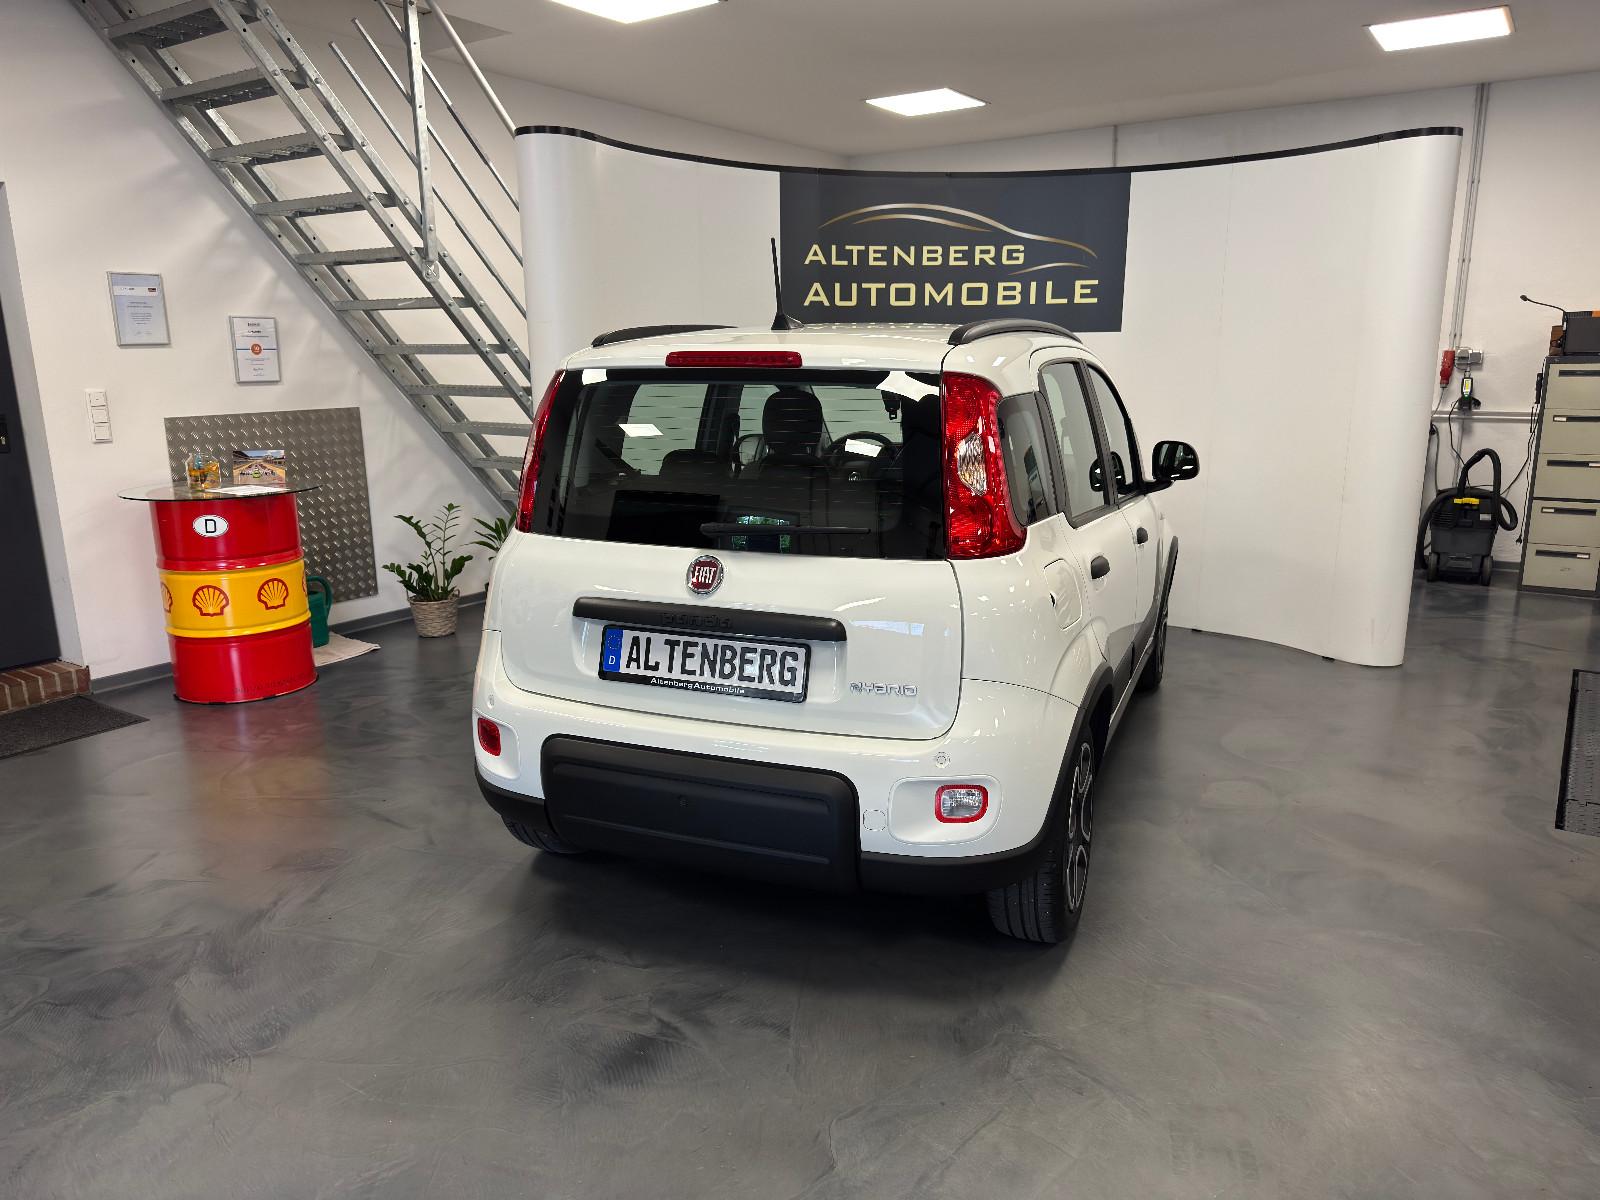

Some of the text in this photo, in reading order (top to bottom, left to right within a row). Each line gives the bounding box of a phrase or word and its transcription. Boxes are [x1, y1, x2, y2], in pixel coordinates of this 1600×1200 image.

[804, 244, 1025, 266] ALTENBERG
[804, 279, 1099, 307] AUTOMOBILE
[205, 519, 217, 534] D
[693, 566, 717, 584] FIAT
[608, 635, 799, 687] D ALTENBERG
[650, 677, 746, 694] Altenberg Automobile
